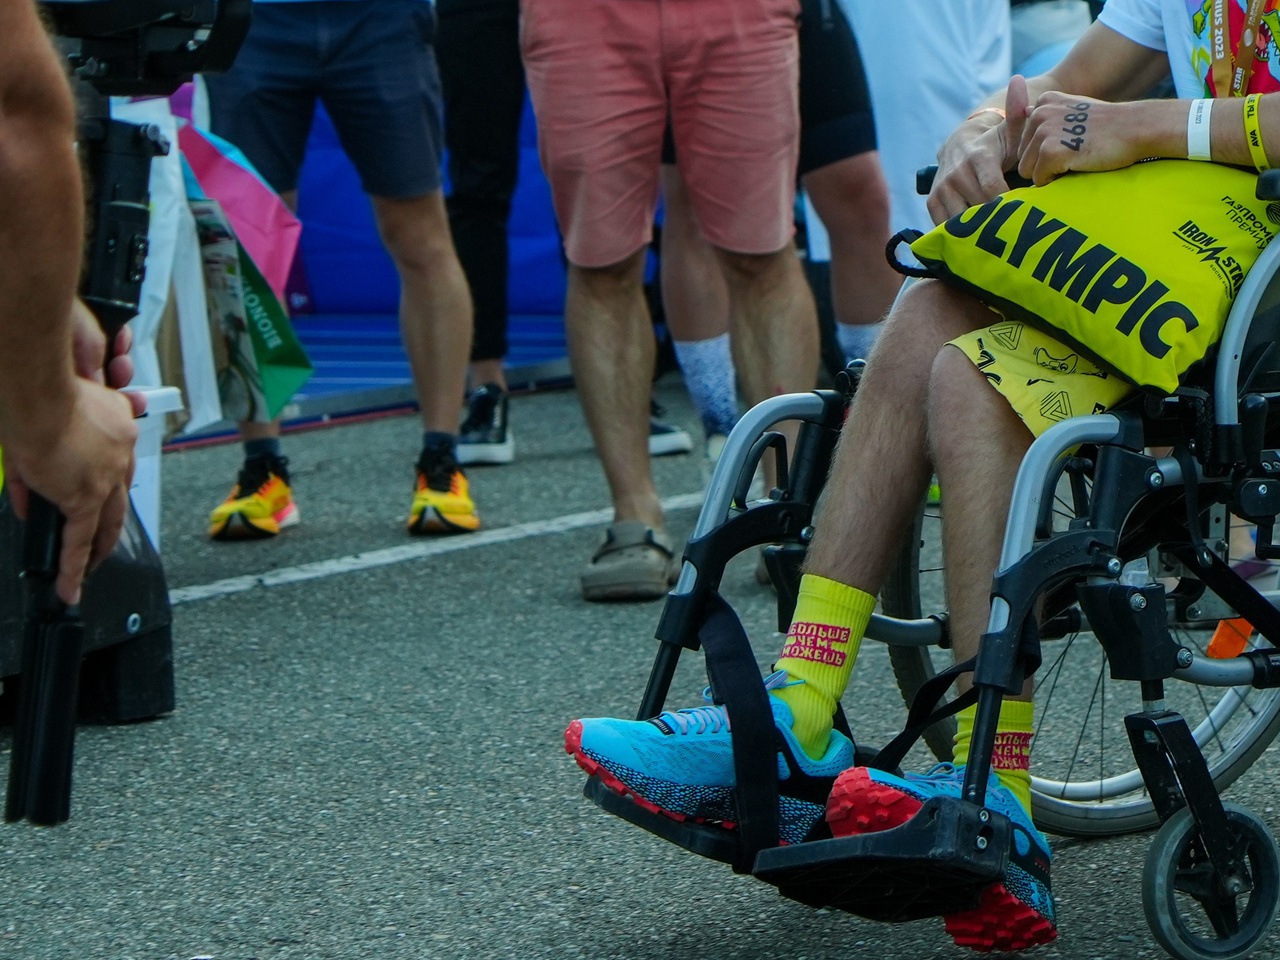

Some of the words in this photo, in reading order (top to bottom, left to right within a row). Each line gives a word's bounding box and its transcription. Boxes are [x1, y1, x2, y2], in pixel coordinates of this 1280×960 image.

[1213, 28, 1225, 60] 2023
[1233, 67, 1243, 90] STAR
[1247, 104, 1255, 118] ТЫ
[1060, 102, 1091, 151] 4686
[1249, 129, 1260, 147] AVA
[1178, 219, 1218, 247] IRON
[1225, 208, 1266, 250] ПРЕМИУ
[944, 195, 1200, 360] OLYMPIC
[243, 283, 283, 350] BIONO
[789, 623, 849, 641] БОЛЬШЕ
[797, 636, 828, 649] ЧЕМ
[782, 645, 843, 665] МОЖЕШЬ
